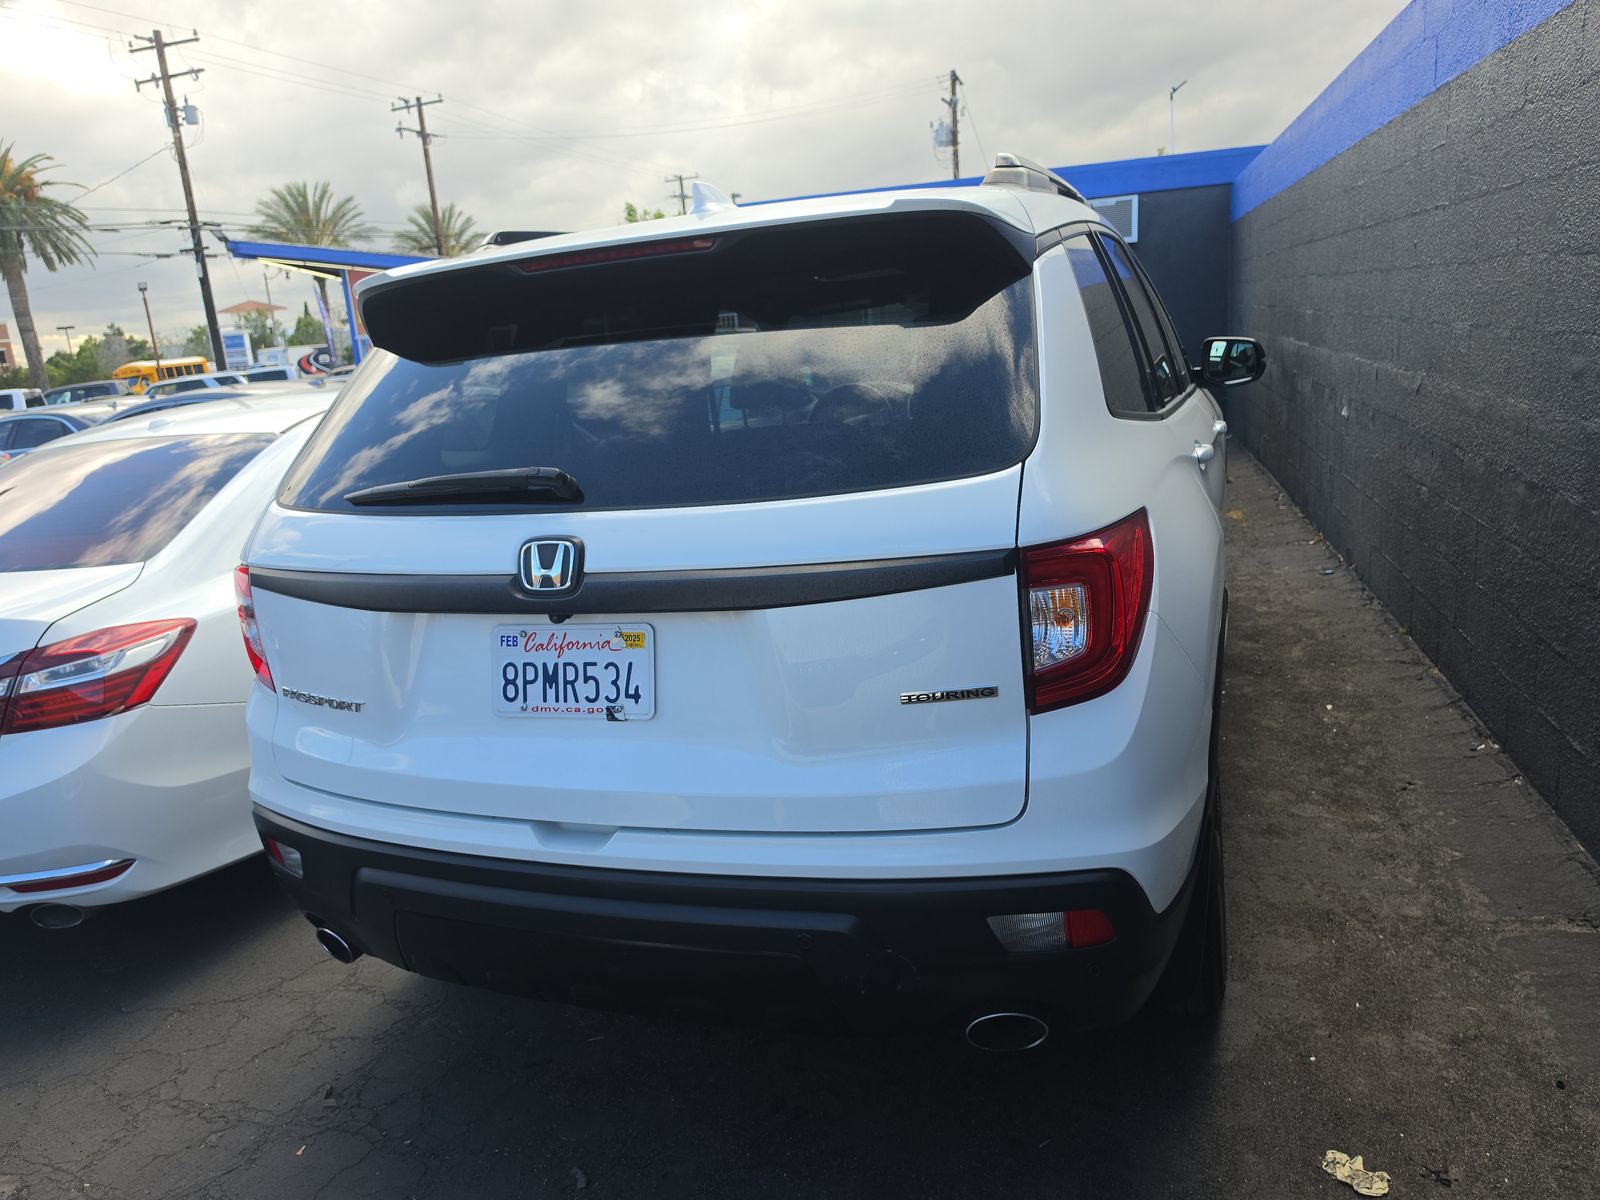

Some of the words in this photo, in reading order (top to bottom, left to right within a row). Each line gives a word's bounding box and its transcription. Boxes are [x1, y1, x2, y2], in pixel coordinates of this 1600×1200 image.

[500, 635, 519, 647] FEB
[524, 632, 623, 659] California
[624, 634, 641, 642] 2025
[502, 661, 642, 704] 8PMR534
[282, 686, 366, 713] PASSPORT
[901, 686, 997, 703] TOURING
[531, 705, 608, 714] dmv.ca.go
